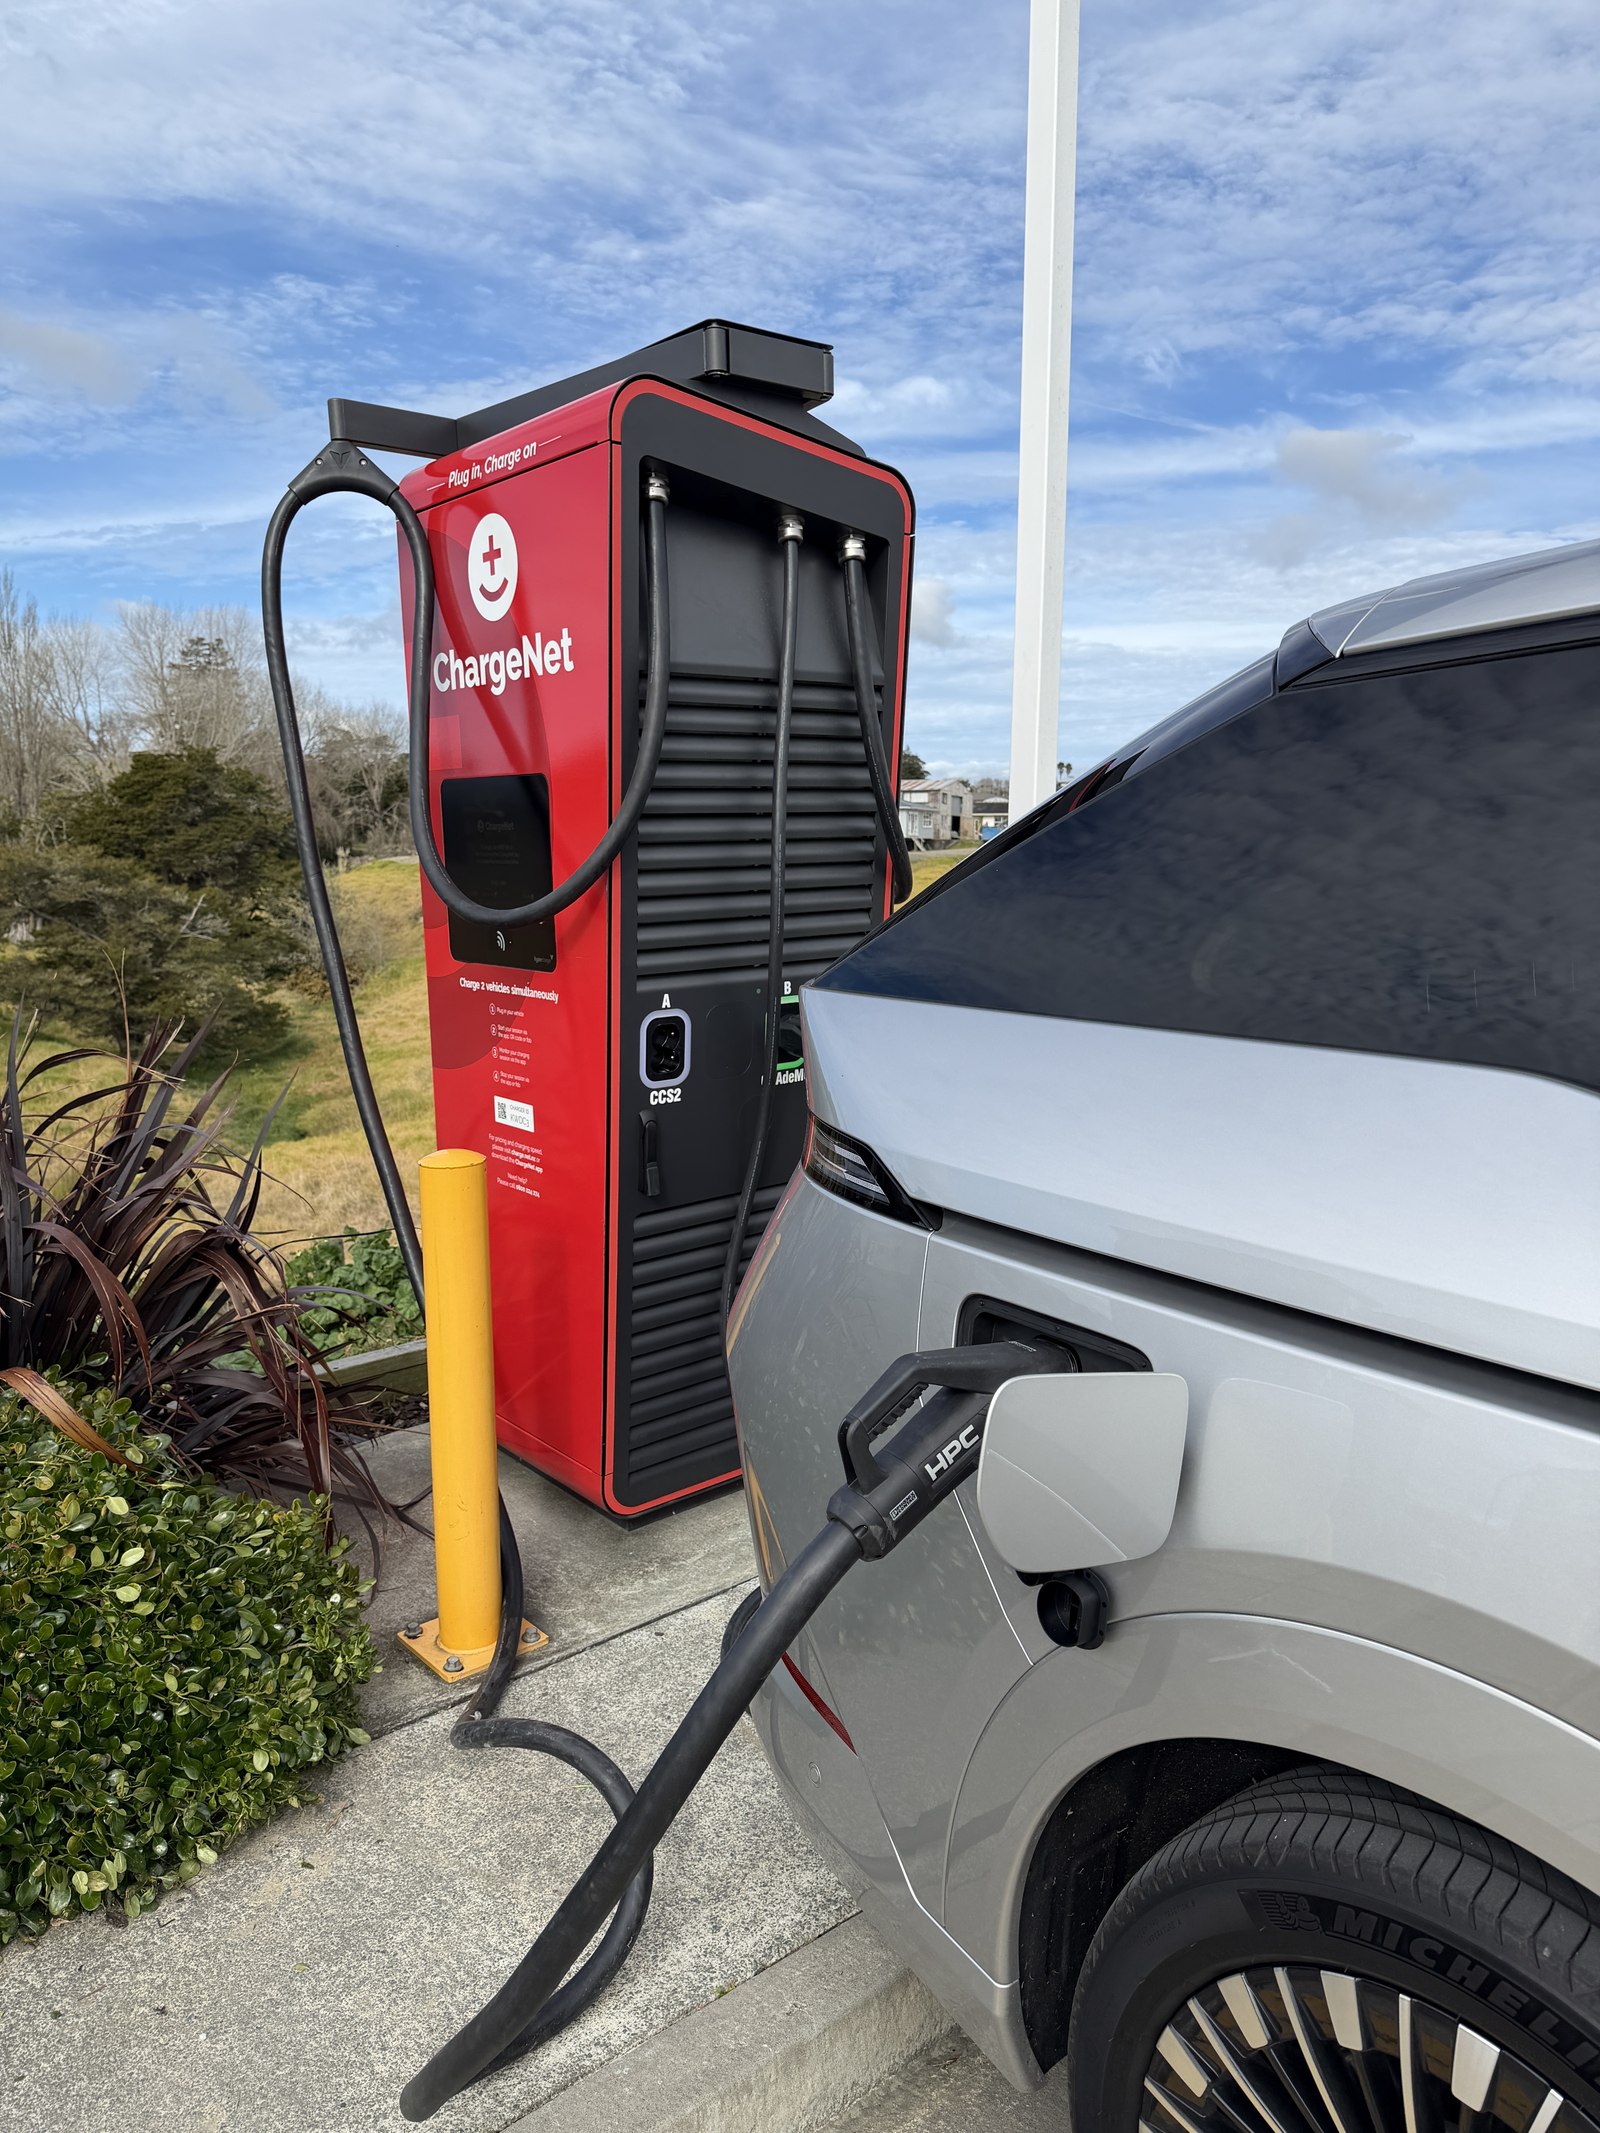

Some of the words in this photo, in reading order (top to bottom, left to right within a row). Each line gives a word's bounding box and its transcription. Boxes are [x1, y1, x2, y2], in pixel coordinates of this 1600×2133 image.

[448, 469, 470, 488] Plug
[471, 462, 482, 479] in,
[484, 448, 521, 475] Charge
[523, 441, 537, 459] on
[433, 627, 574, 695] ChargeNet
[459, 977, 480, 991] Charge
[481, 981, 485, 991] 2
[486, 982, 510, 994] vehicles
[511, 984, 559, 1004] simultaneously
[661, 993, 671, 1009] A
[784, 981, 792, 995] B
[650, 1088, 682, 1105] CCS2
[924, 1424, 980, 1481] HPC
[1333, 1905, 1600, 2086] MICHELI
